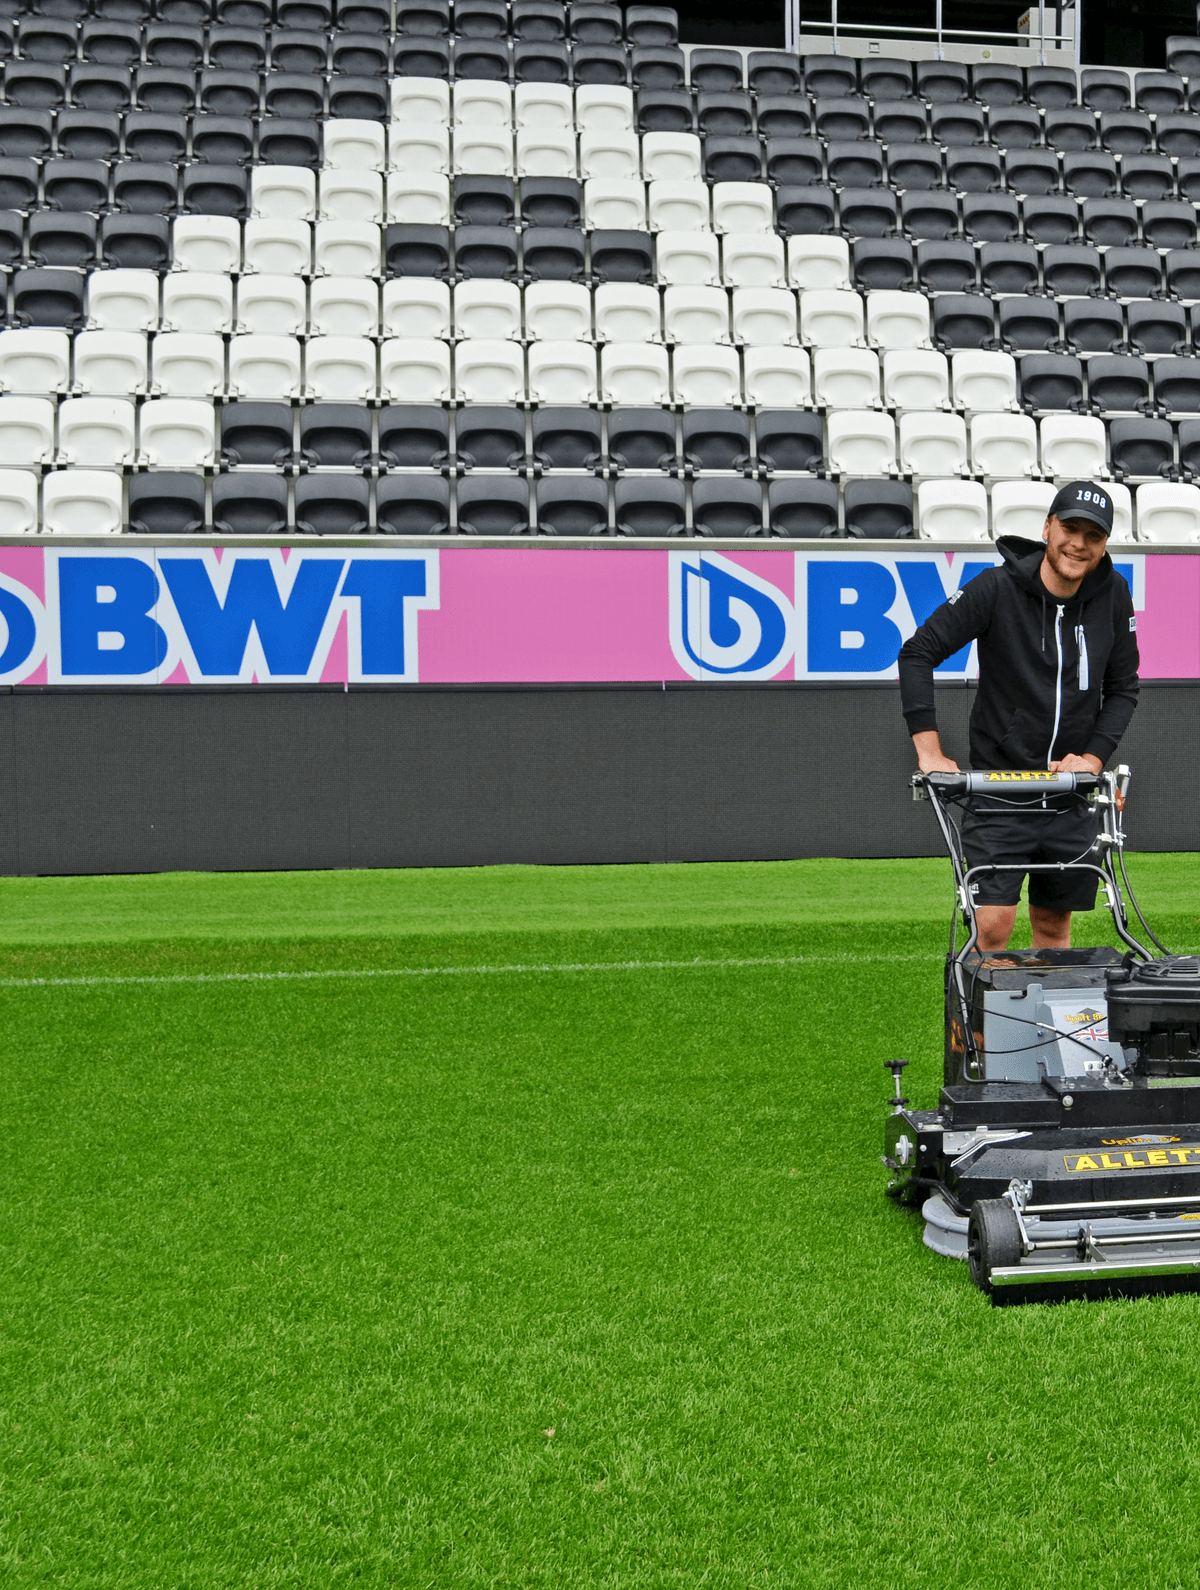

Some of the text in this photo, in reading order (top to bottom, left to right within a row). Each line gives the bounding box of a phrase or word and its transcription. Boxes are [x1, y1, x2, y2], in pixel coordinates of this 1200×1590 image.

[1076, 490, 1107, 508] 1908
[58, 557, 426, 676] BWT
[989, 772, 1053, 781] ALLETT
